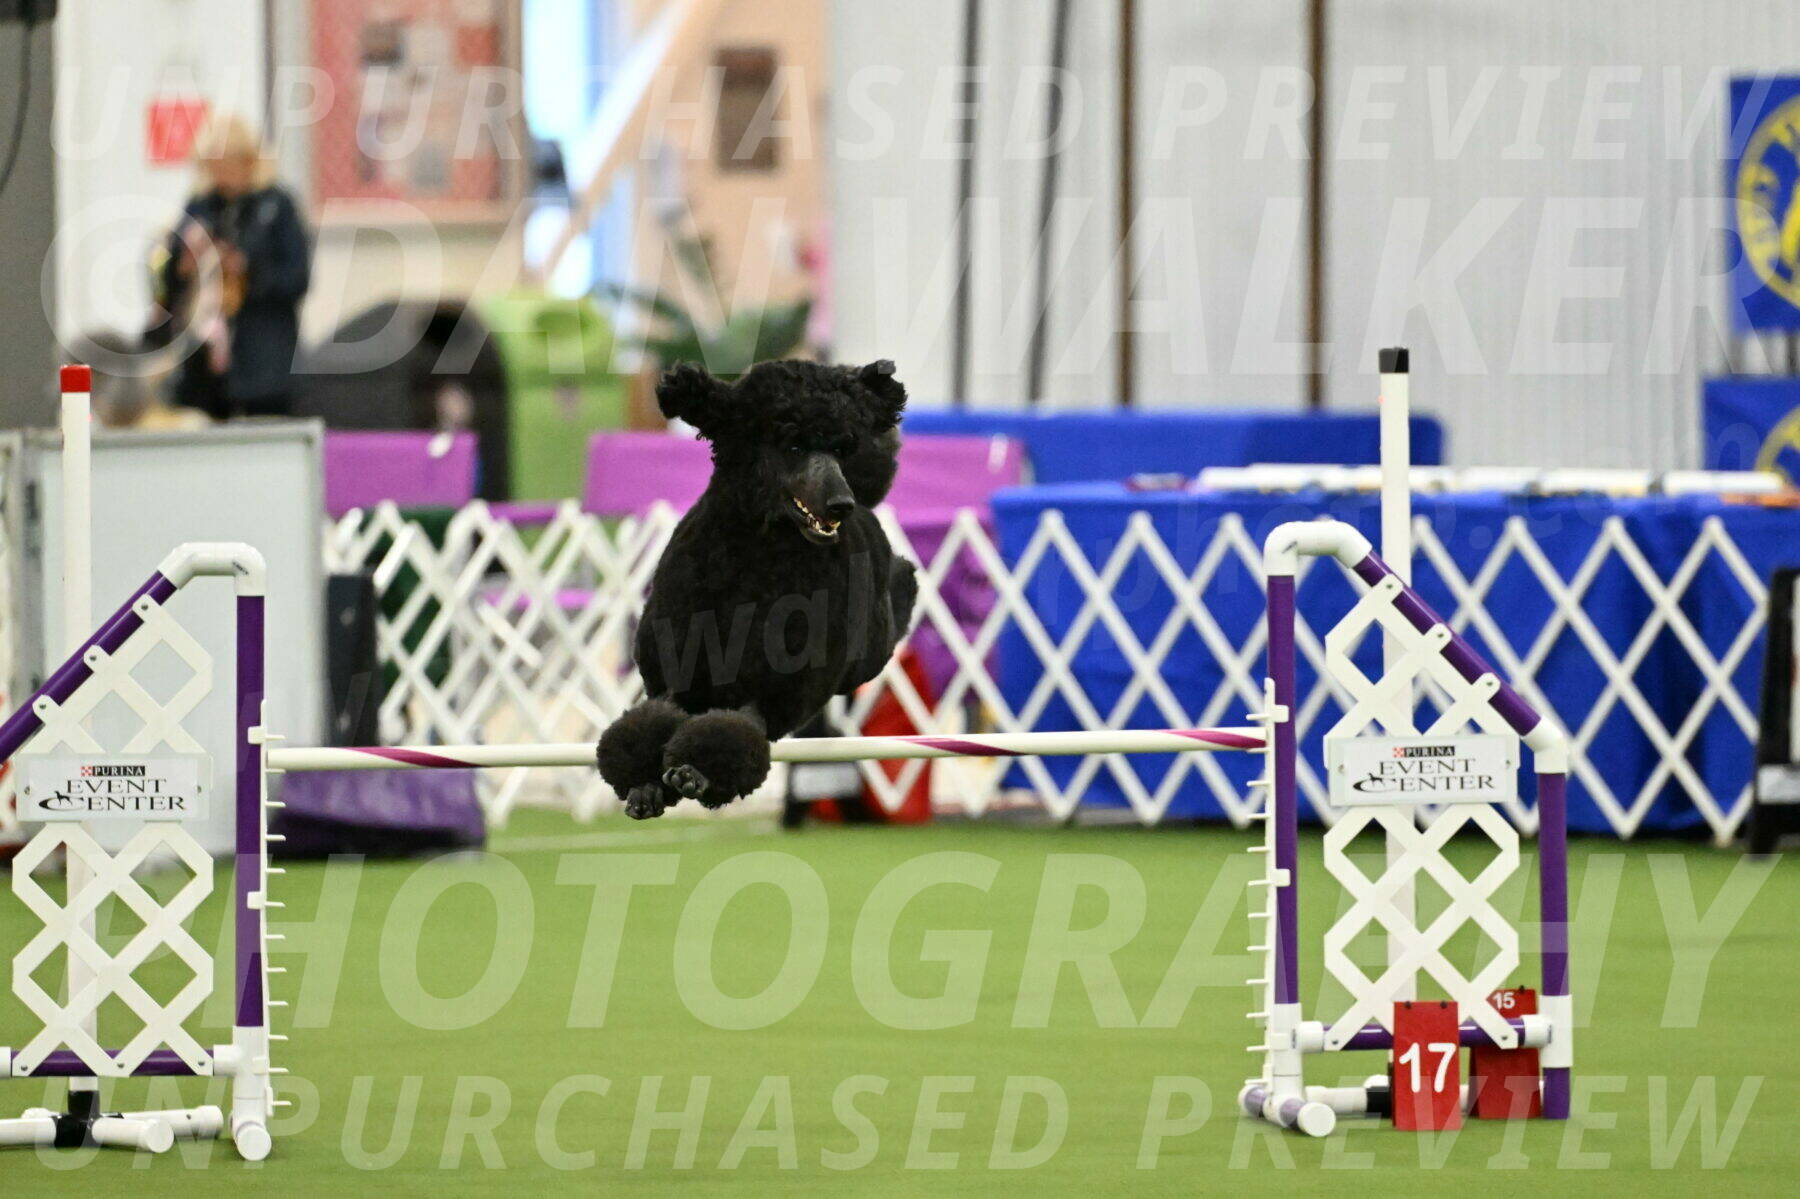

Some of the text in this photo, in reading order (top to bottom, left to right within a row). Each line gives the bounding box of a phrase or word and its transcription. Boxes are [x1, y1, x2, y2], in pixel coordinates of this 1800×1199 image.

[1404, 745, 1456, 757] PURINA
[93, 765, 145, 776] PURINA
[1379, 758, 1476, 776] EVENT
[66, 778, 166, 794] EVENT
[1353, 775, 1495, 793] CENTER
[38, 795, 187, 812] CENTER
[1492, 991, 1517, 1010] 15
[1398, 1042, 1457, 1093] 17
